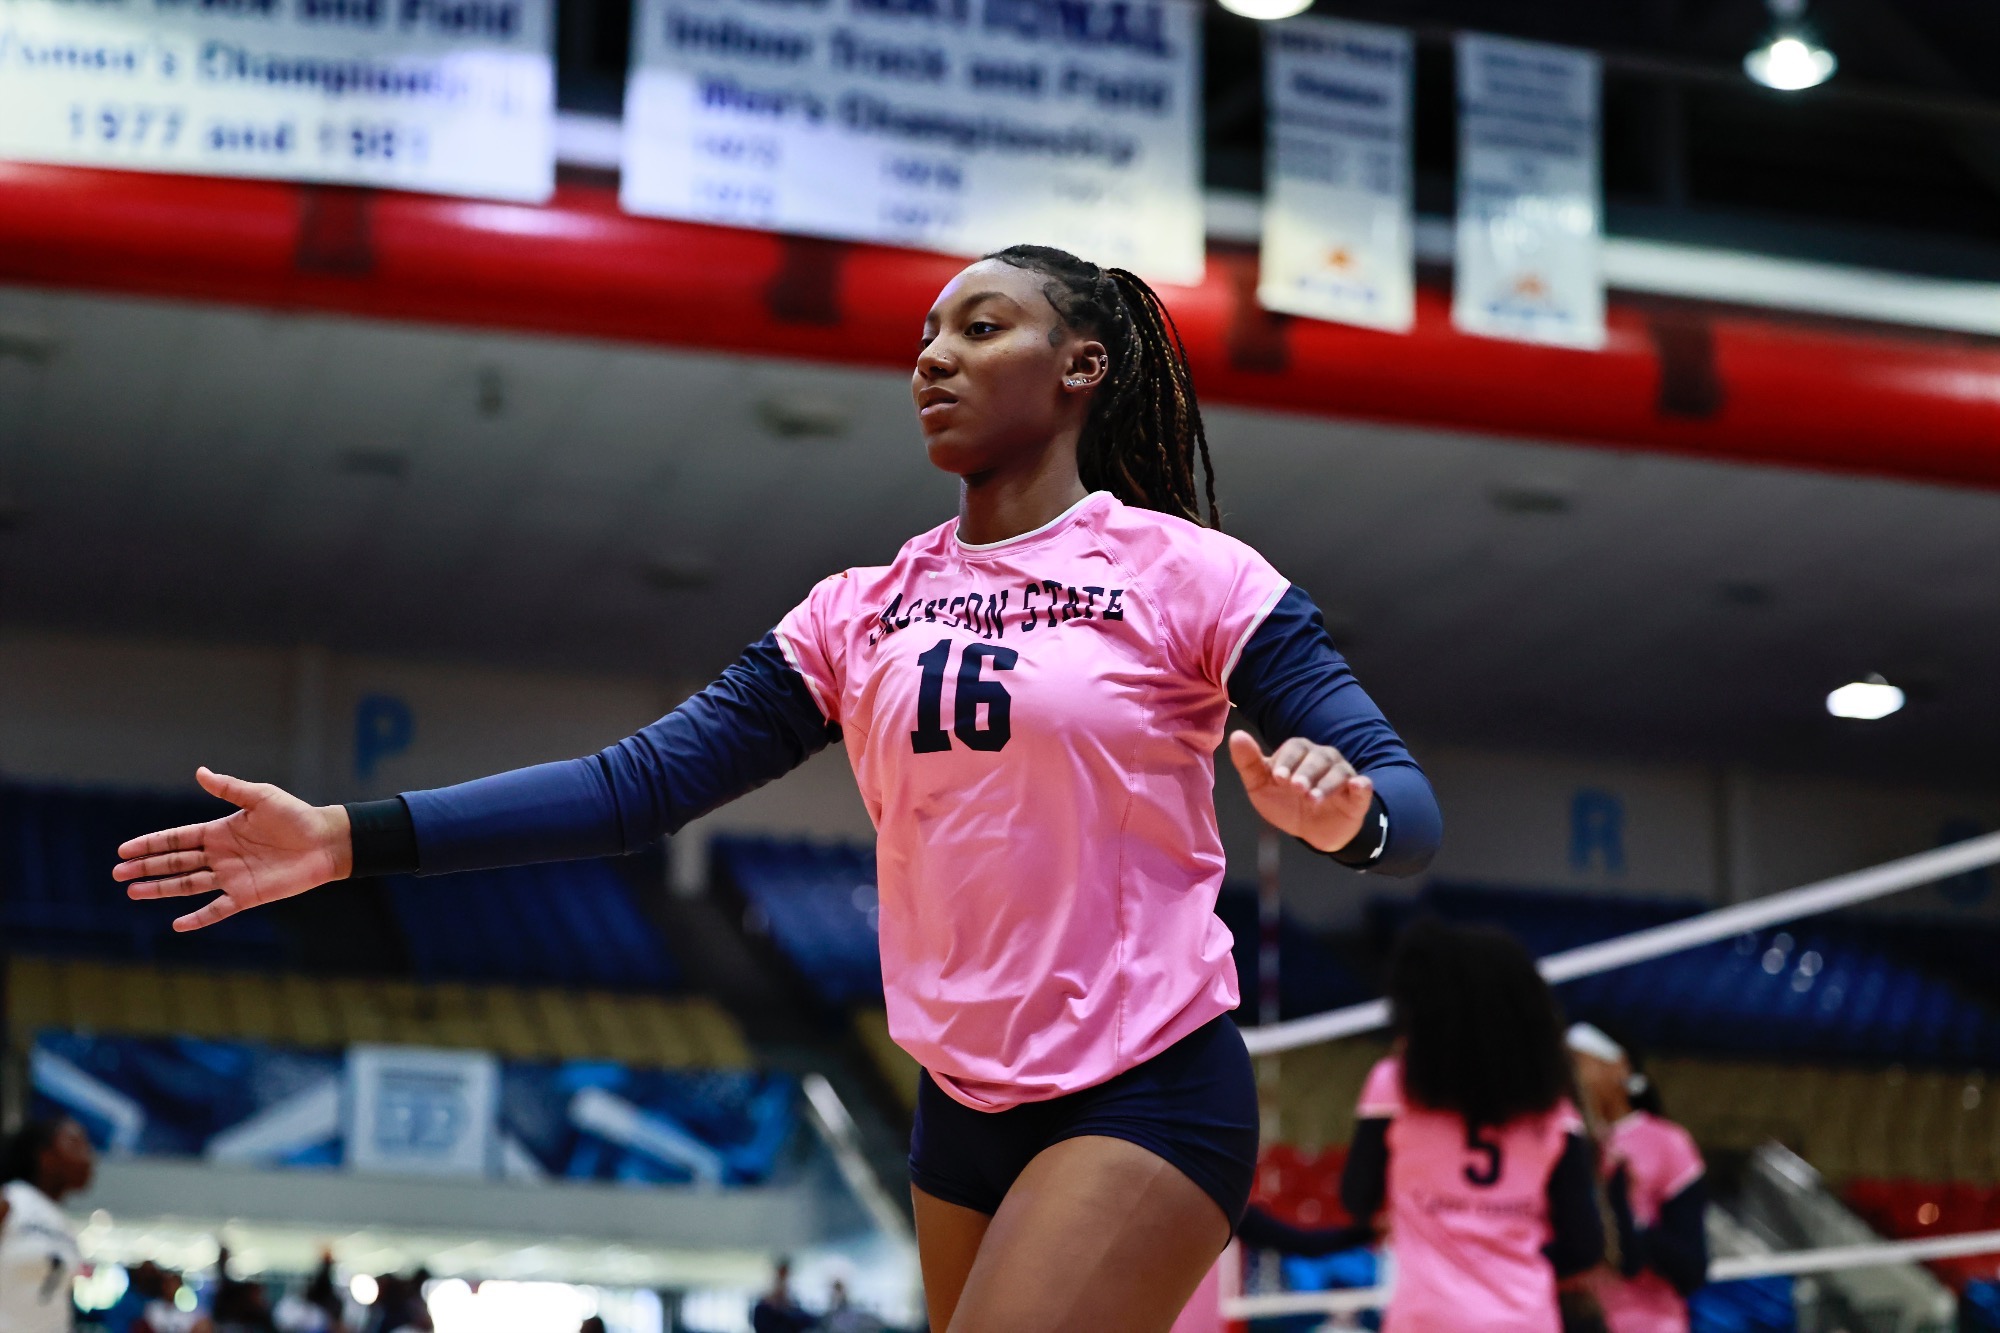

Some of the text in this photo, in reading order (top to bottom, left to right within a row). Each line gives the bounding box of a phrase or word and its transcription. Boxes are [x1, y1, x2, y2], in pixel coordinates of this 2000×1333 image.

[827, 30, 948, 82] Track
[970, 60, 1044, 95] and
[852, 0, 1178, 57] IONAL
[0, 28, 515, 112] omen's Champions
[70, 105, 185, 145] 1977
[205, 119, 292, 155] and
[869, 580, 1124, 646] ACSON STATE
[911, 638, 1019, 754] 16
[355, 694, 415, 782] P
[1571, 789, 1625, 872] R
[1464, 1114, 1503, 1187] 5
